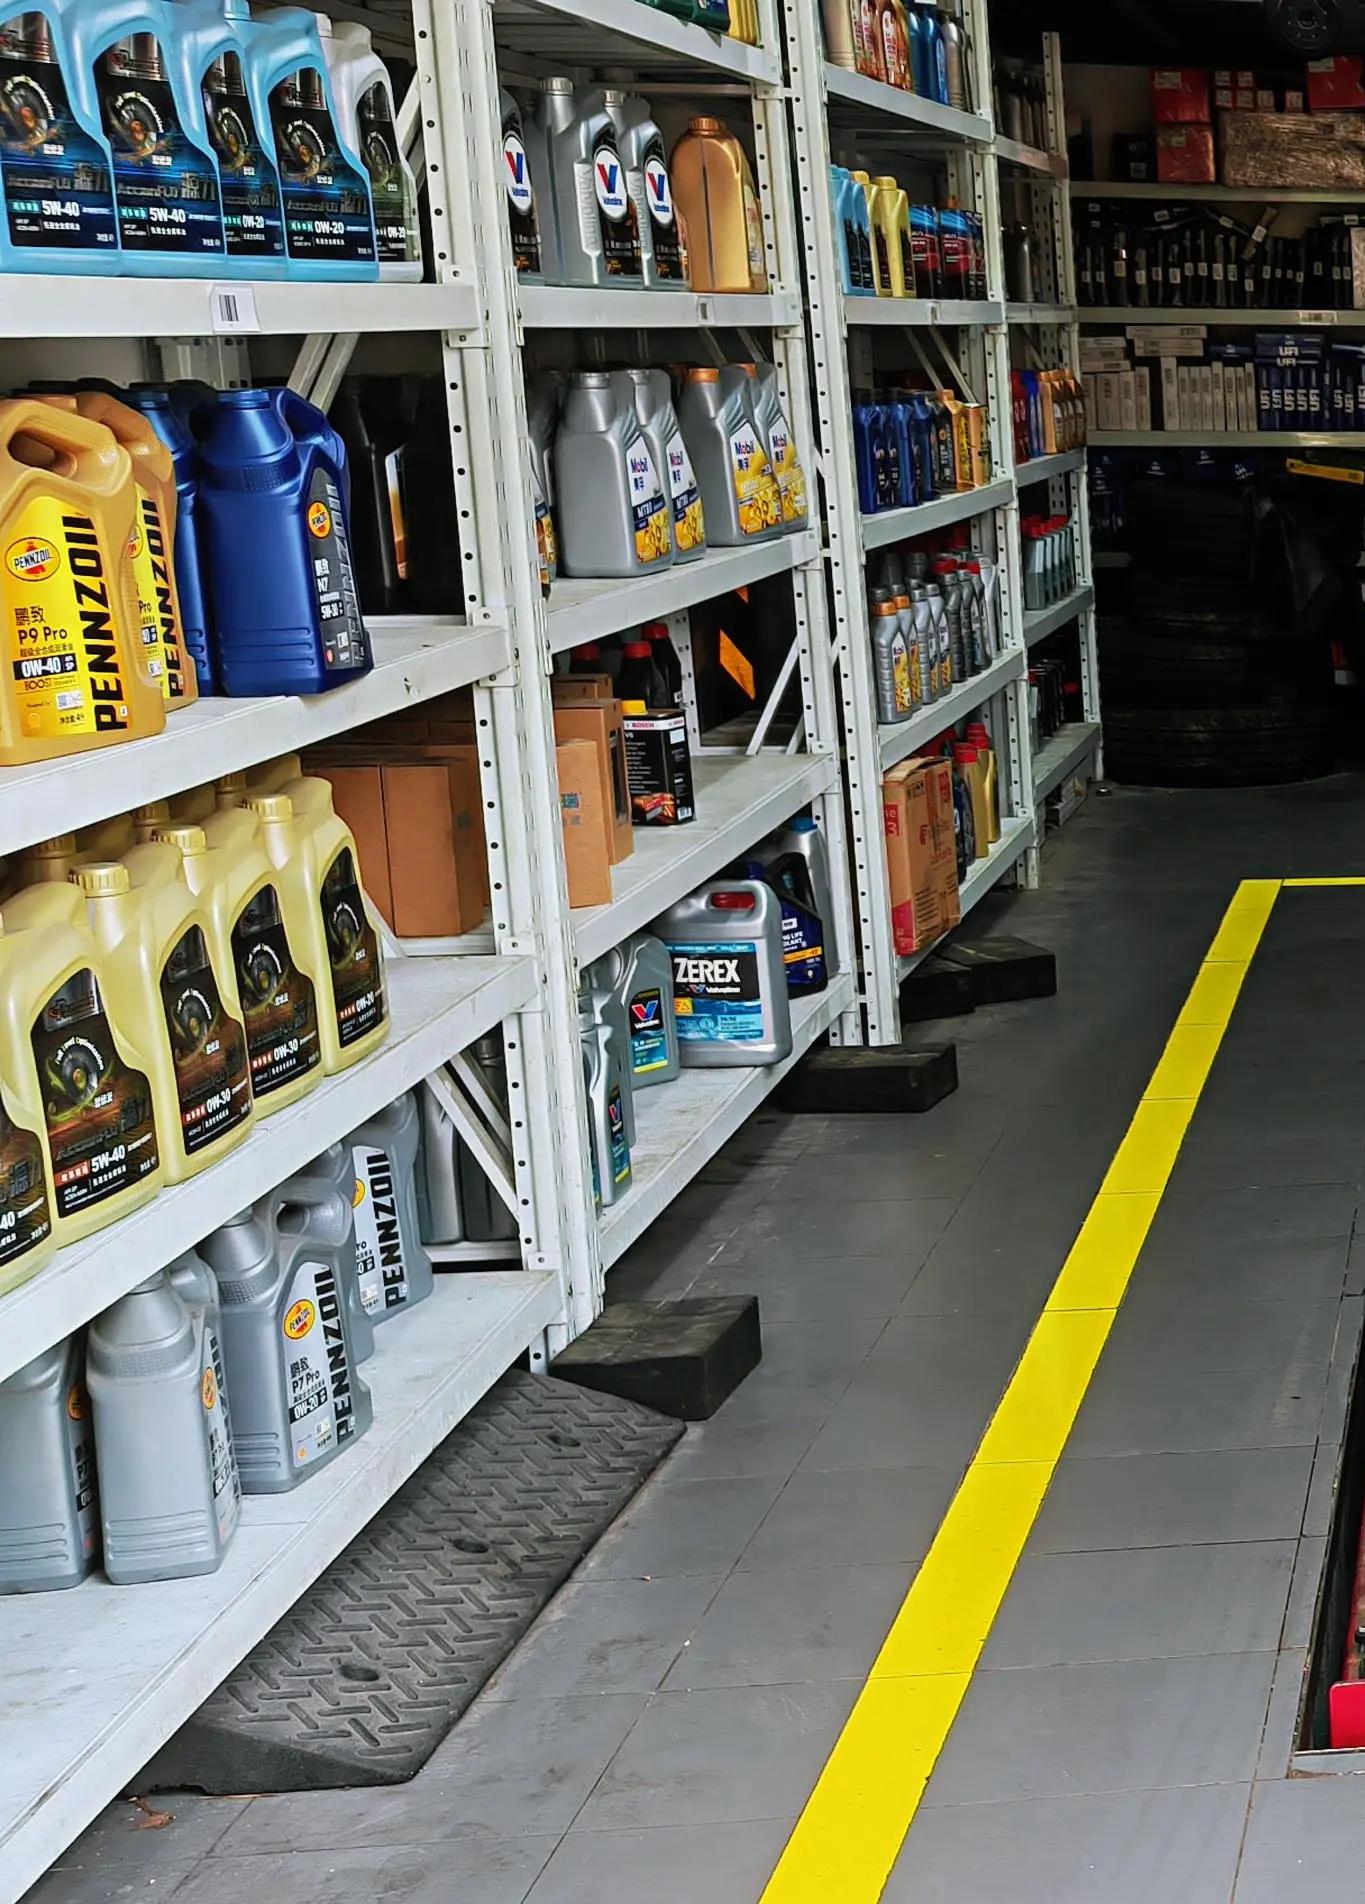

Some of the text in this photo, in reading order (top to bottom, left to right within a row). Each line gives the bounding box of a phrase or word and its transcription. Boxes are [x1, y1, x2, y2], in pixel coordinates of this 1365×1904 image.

[42, 201, 81, 217] 5W-40
[150, 208, 186, 223] 5W-40
[314, 221, 345, 234] 0W-20
[1279, 346, 1298, 356] UFI
[1260, 389, 1270, 410] UFI
[1284, 389, 1295, 411] UFI
[1297, 389, 1307, 411] UFI
[1309, 389, 1320, 411] UFI
[734, 440, 755, 455] Mobil
[772, 433, 787, 449] Mobil
[630, 457, 648, 473] Mobil
[669, 450, 683, 466] Mobil
[13, 548, 53, 571] PENNZOIL
[141, 499, 184, 697] PENNZOIL
[62, 515, 128, 732] PENNZOIL
[18, 625, 68, 646] P9 Pro
[21, 656, 62, 678] 0W-40
[673, 957, 741, 983] ZEREX
[273, 1038, 299, 1062] 0W-30
[206, 1087, 231, 1114] 0W-30
[91, 1144, 126, 1173] 5W-40
[366, 1152, 407, 1309] PENNZOIL
[290, 1309, 310, 1332] PENNZOIL
[314, 1266, 355, 1445] PENNZOIL
[291, 1369, 320, 1395] P7 Pro
[294, 1396, 318, 1420] 0W-20
